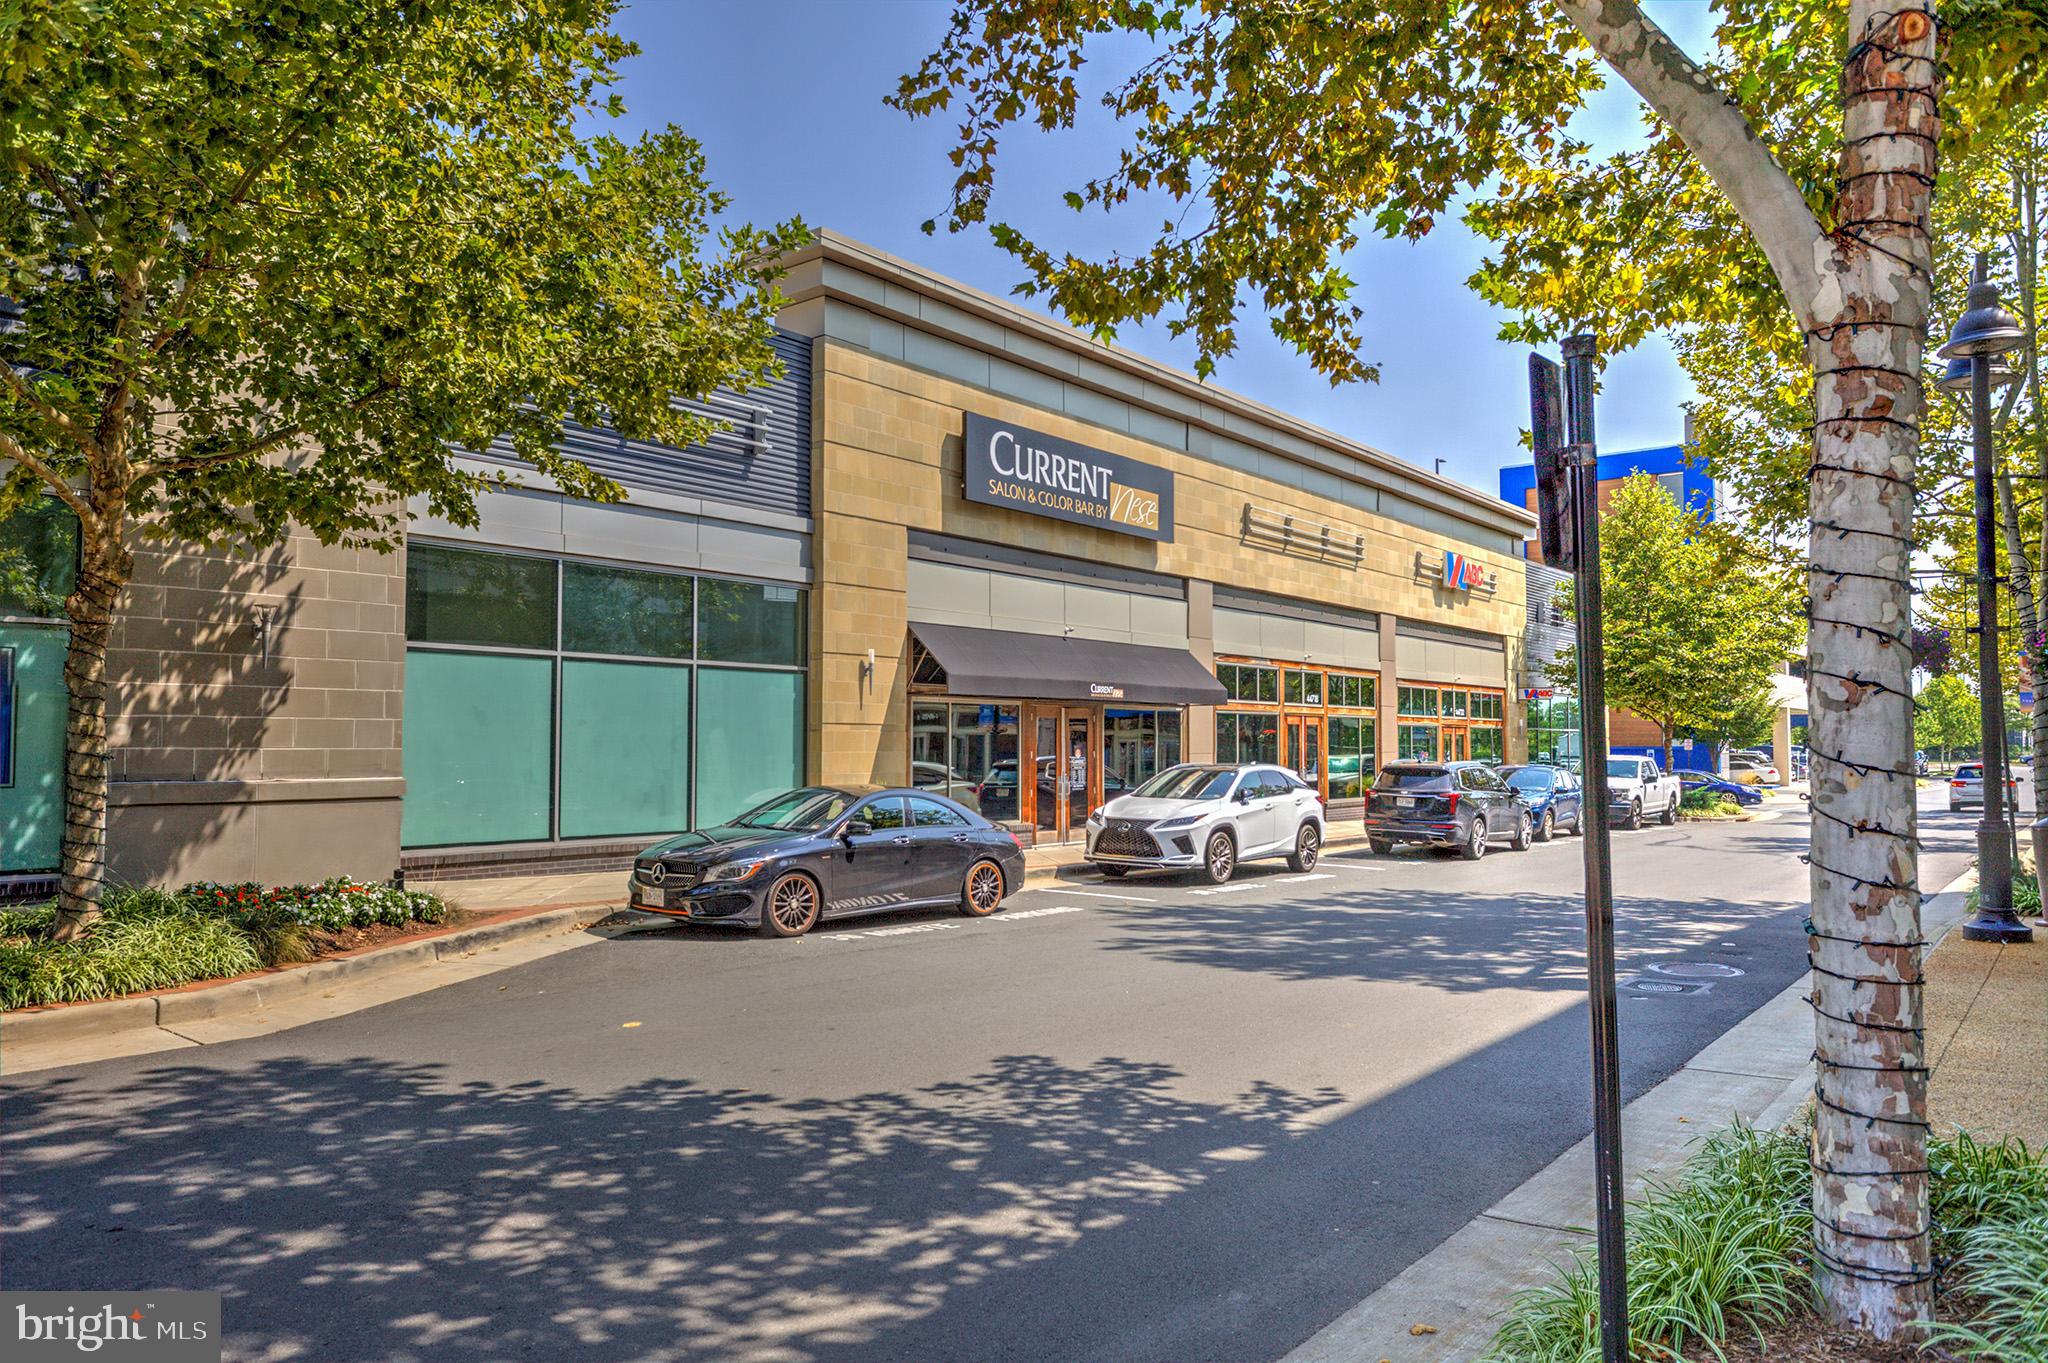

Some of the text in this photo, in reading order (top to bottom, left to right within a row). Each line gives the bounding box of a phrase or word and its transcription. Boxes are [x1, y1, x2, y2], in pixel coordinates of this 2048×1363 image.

[989, 430, 1113, 500] CURRENT
[988, 478, 1026, 502] SALON
[1028, 489, 1037, 504] &
[1038, 491, 1073, 511] COLOR
[1075, 499, 1095, 516] BAR
[1096, 503, 1108, 520] BY
[1463, 563, 1484, 587] ABC
